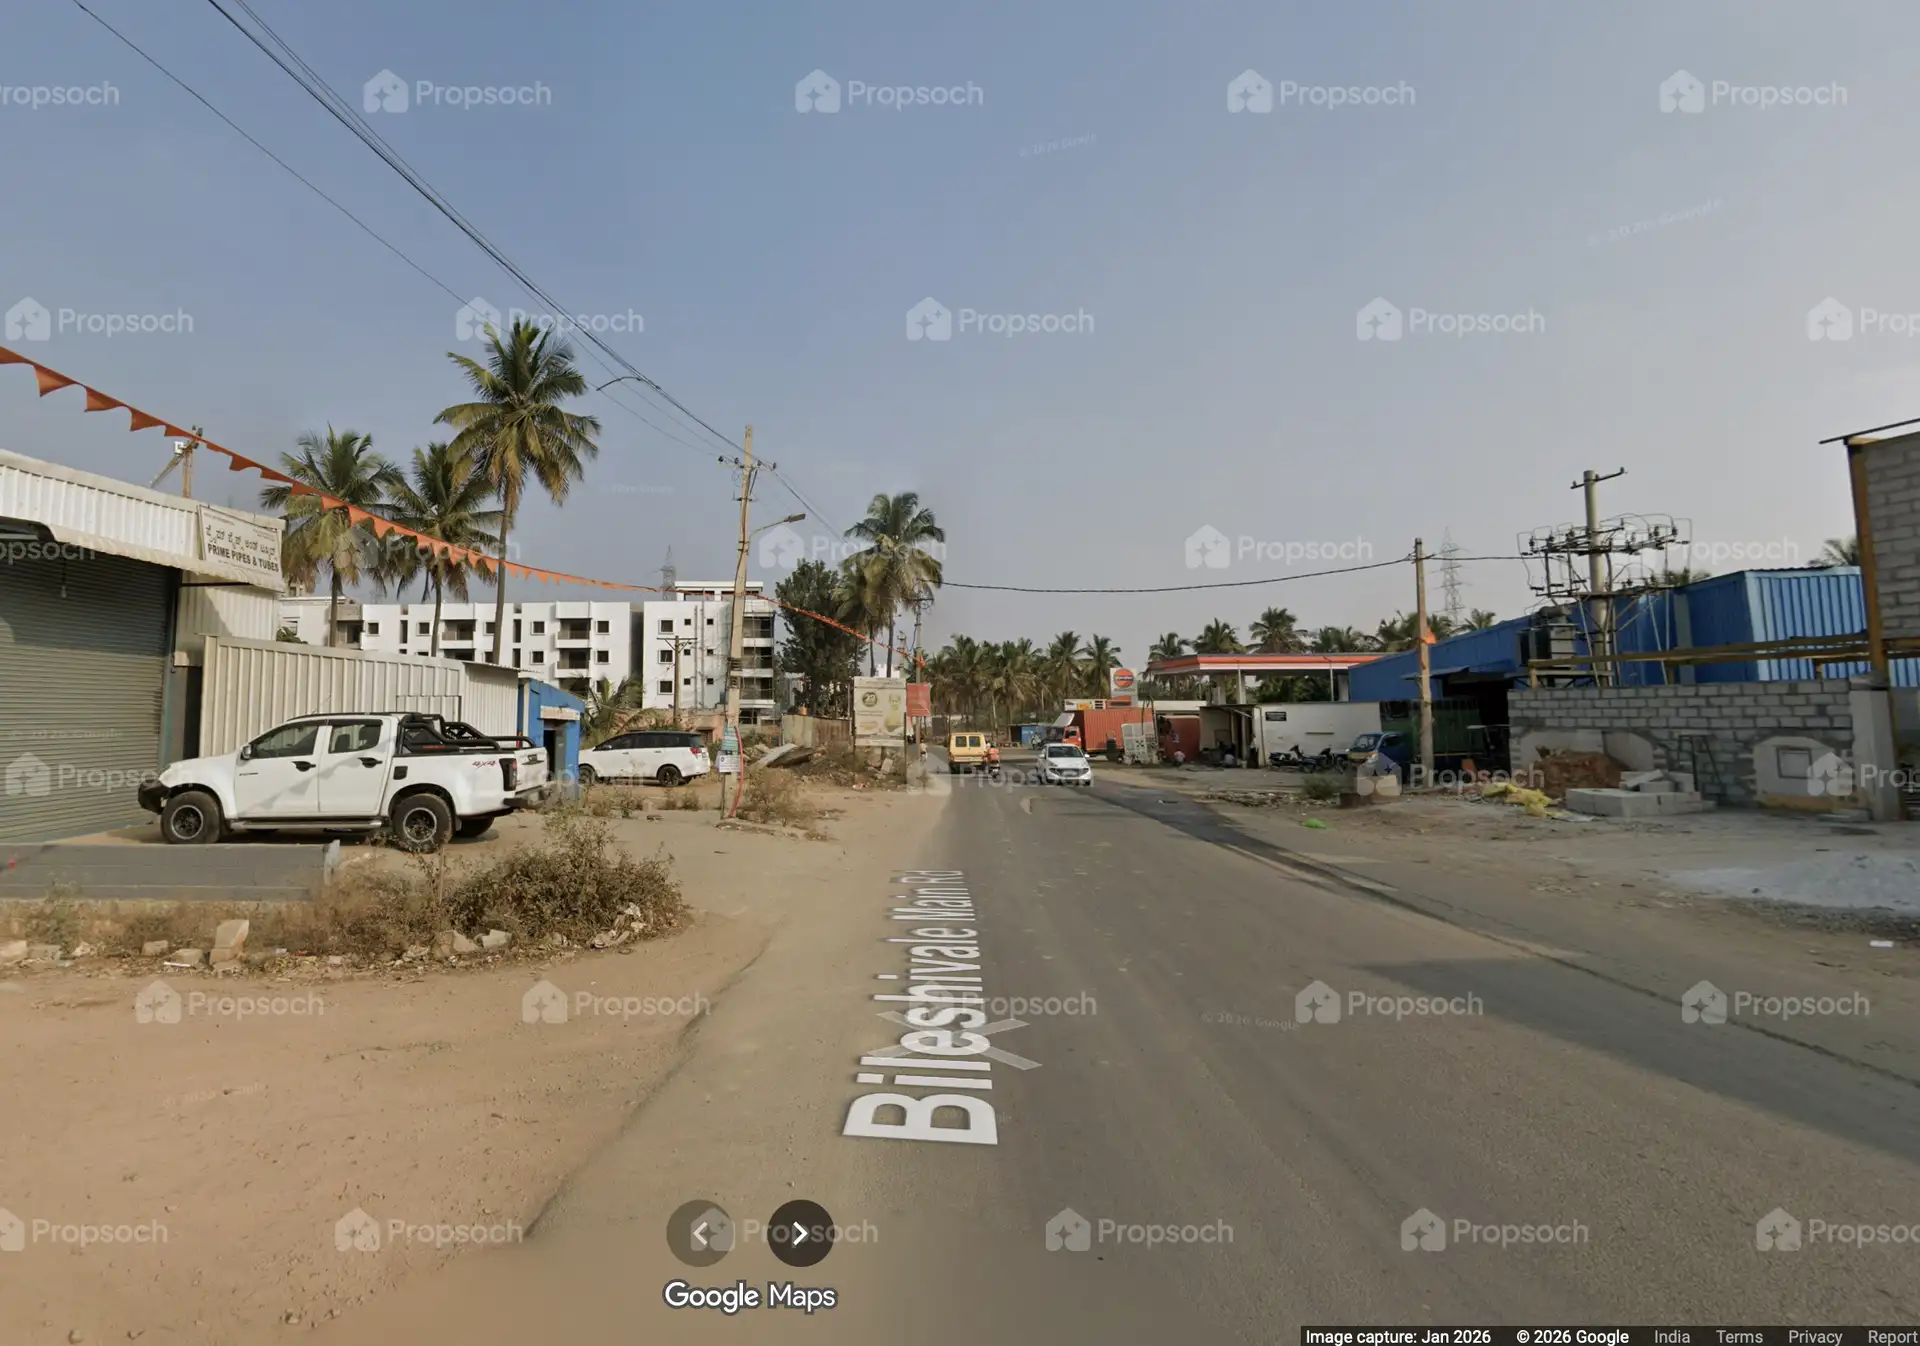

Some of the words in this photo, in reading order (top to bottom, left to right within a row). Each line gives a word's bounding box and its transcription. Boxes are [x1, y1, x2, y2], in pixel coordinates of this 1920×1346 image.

[207, 543, 231, 559] PRIME
[231, 550, 251, 565] PIPES
[252, 557, 257, 566] &
[258, 558, 279, 573] TUBES
